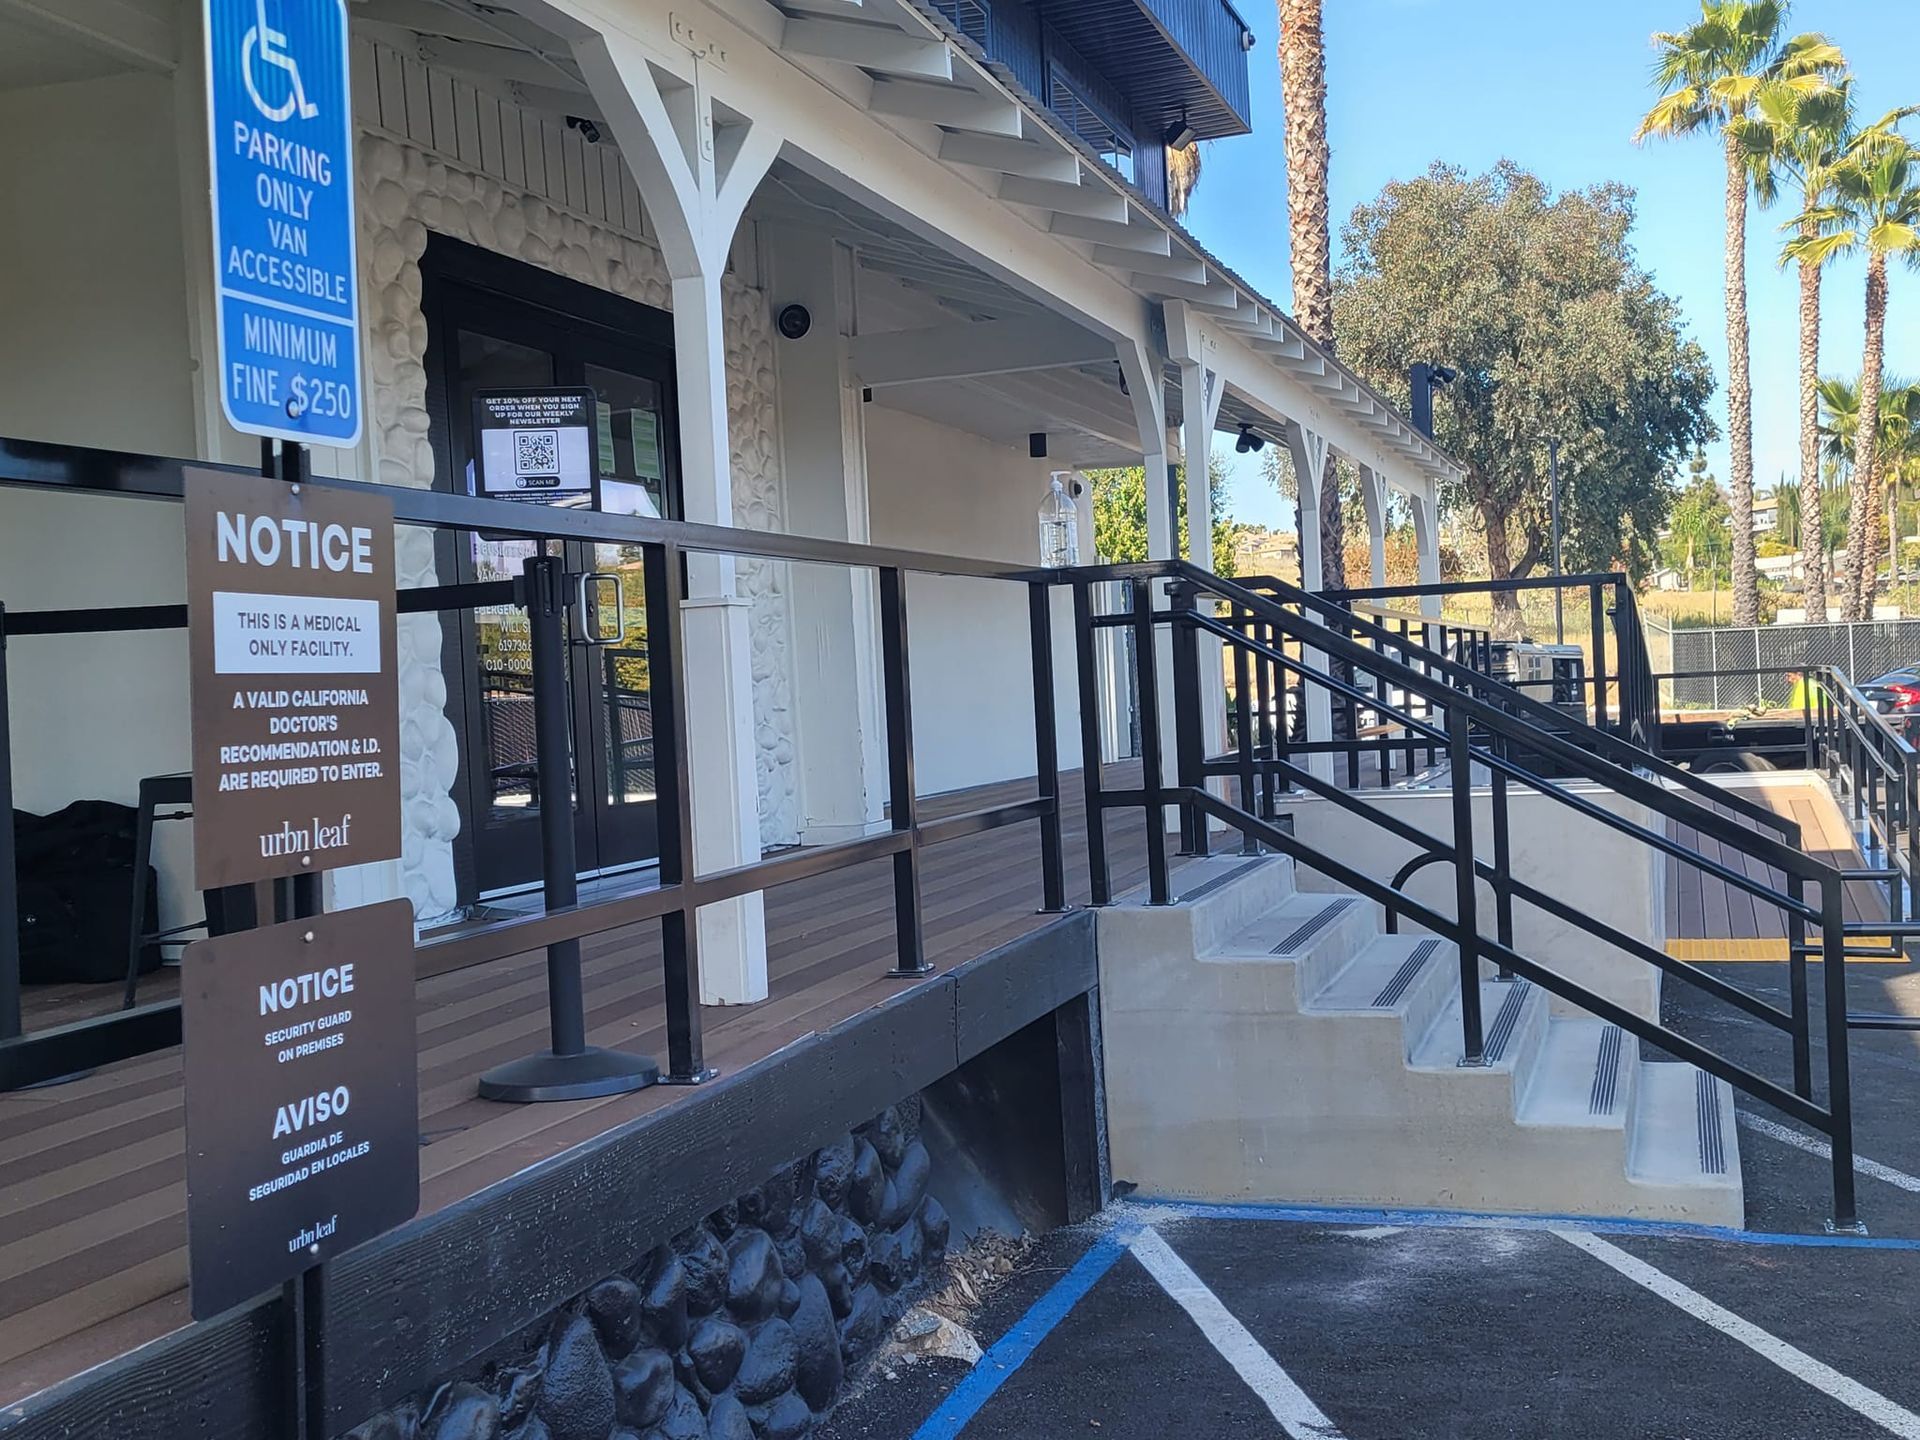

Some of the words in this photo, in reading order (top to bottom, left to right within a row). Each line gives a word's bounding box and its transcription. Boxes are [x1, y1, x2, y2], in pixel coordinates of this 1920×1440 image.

[233, 120, 332, 187] PARKING
[256, 172, 314, 222] ONLY
[267, 217, 308, 258] VAN
[227, 245, 348, 305] ACCESSIBLE
[243, 312, 338, 369] MINIMUM
[232, 362, 281, 408] FINE
[290, 372, 351, 420] $250
[509, 417, 561, 425] NEWSLETTER
[216, 511, 374, 574] NOTICE
[238, 612, 270, 629] THIS
[274, 614, 286, 630] IS
[291, 615, 300, 630] A
[304, 615, 361, 632] MEDICAL
[249, 639, 288, 656] ONLY
[291, 640, 353, 657] FACILITY.
[233, 691, 245, 709] A
[247, 691, 289, 708] VALID
[292, 689, 369, 707] CALIFORNIA
[270, 715, 338, 734] DOCTOR'S
[220, 739, 349, 764] RECOMMENDATION
[351, 739, 360, 755] &
[363, 738, 381, 754] I.D.
[218, 772, 249, 792] ARE
[251, 767, 318, 790] REQUIRED
[320, 765, 339, 782] TO
[341, 762, 384, 781] ENTER.
[259, 821, 310, 858] urbn
[312, 813, 352, 851] leaf
[259, 963, 355, 1016] NOTICE
[264, 1020, 316, 1046] SECURITY
[317, 1010, 352, 1030] GUARD
[278, 1047, 294, 1063] ON
[296, 1033, 345, 1058] PREMISES
[272, 1085, 350, 1140] AVISO
[281, 1137, 328, 1165] GUARDIA
[329, 1131, 344, 1147] DE
[249, 1167, 309, 1202] SEGURIDAD
[311, 1158, 325, 1175] EN
[326, 1141, 370, 1169] LOCALES
[288, 1228, 315, 1253] urbn
[315, 1214, 338, 1240] leaf
